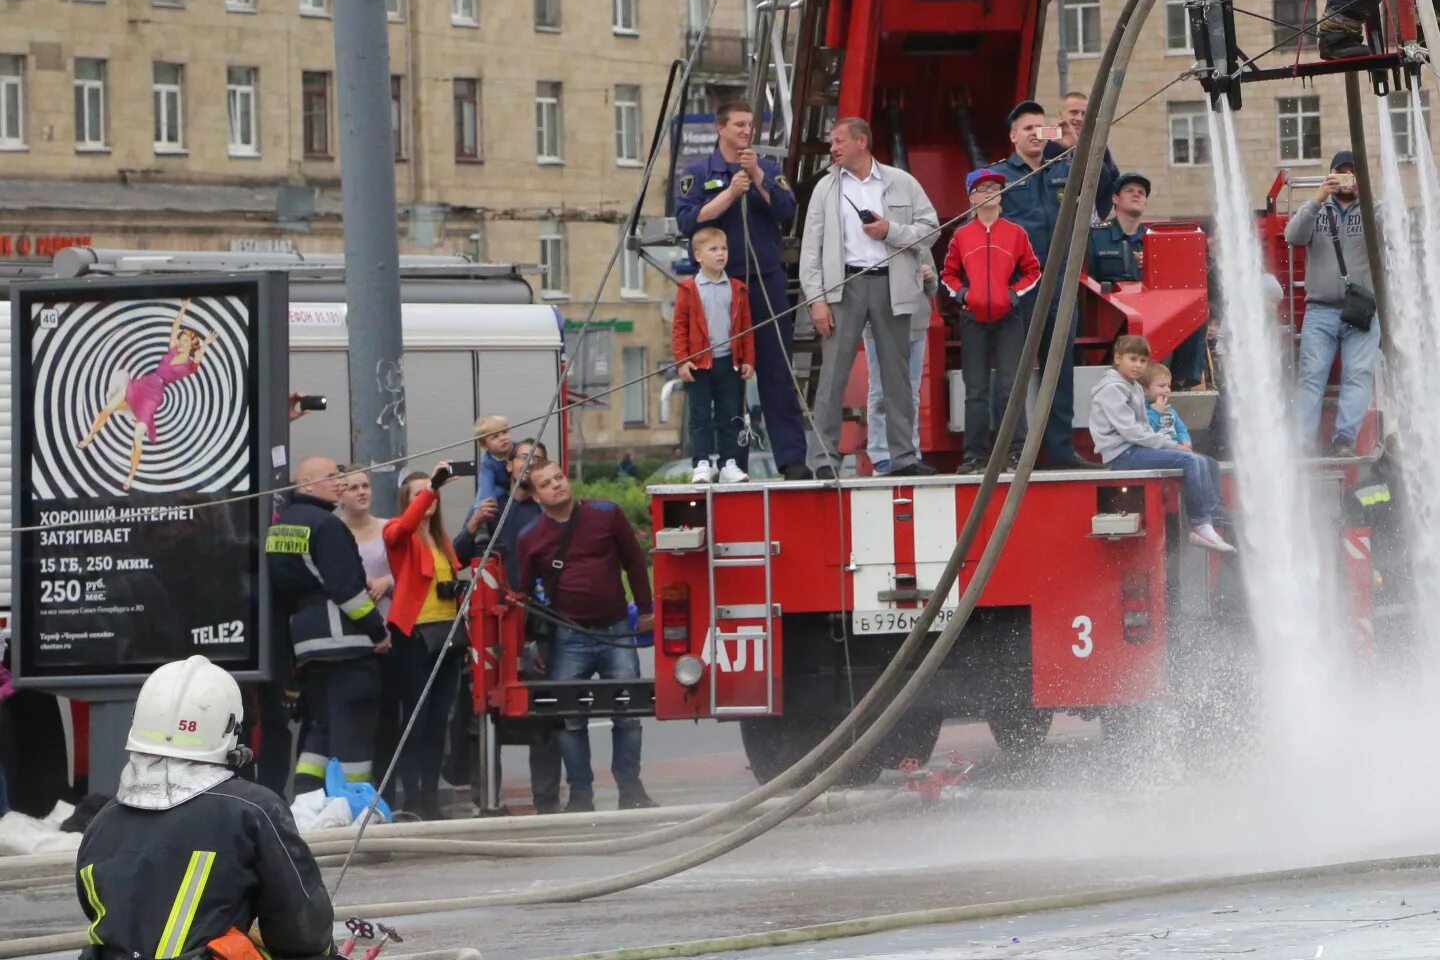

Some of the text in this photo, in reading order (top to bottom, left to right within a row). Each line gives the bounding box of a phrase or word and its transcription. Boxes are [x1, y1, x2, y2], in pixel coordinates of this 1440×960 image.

[42, 313, 56, 324] 4G
[39, 506, 195, 526] ХОРОШИЙ ИНТЕРНЕТ
[39, 528, 132, 546] ЗАТЯГИВАЕТ
[40, 556, 154, 574] 15 ГБ, 250 мин.
[40, 578, 106, 603] 250 руб.
[85, 593, 106, 601] мес.
[191, 619, 245, 645] TELE2
[1071, 615, 1093, 658] 3
[701, 624, 764, 673] АЛ
[178, 719, 197, 732] 58
